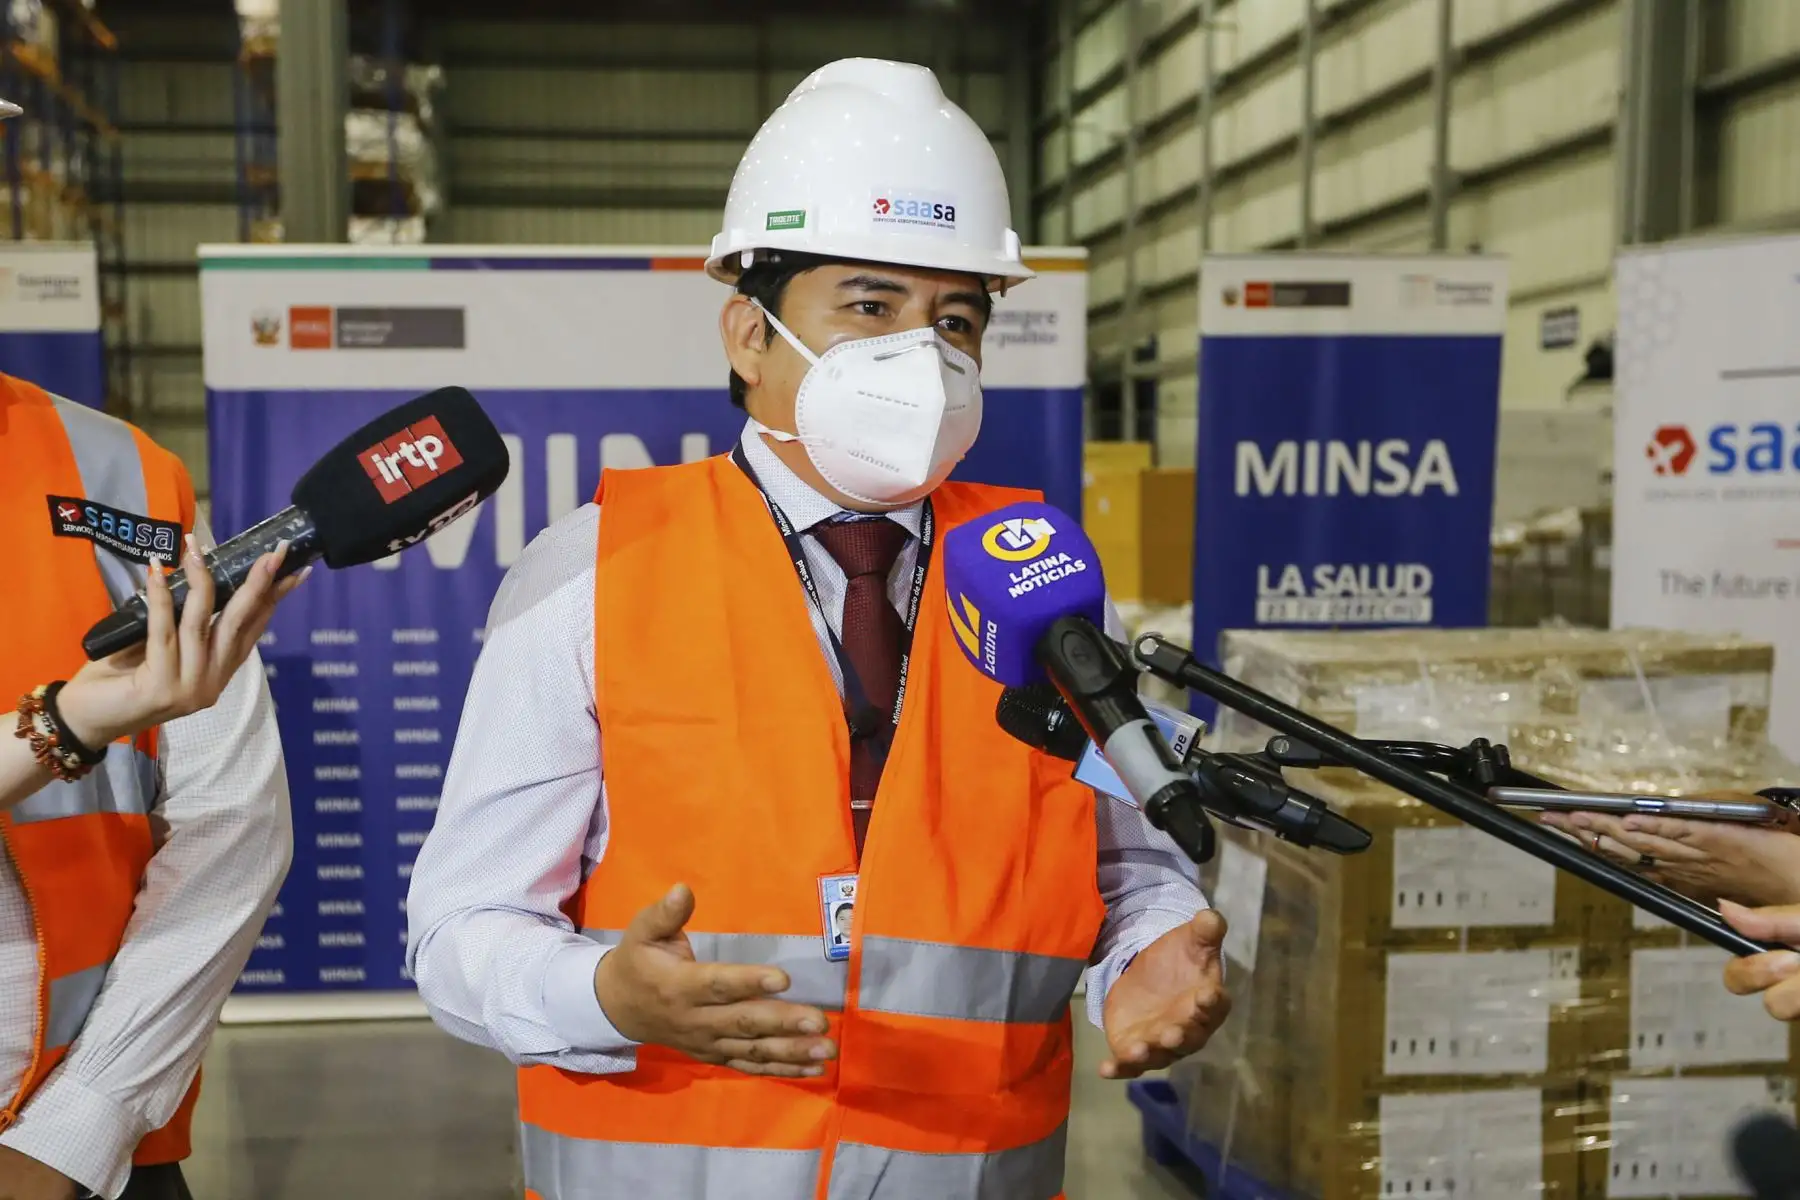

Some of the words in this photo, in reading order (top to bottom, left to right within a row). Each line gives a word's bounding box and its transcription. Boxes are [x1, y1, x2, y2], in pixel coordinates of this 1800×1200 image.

[893, 198, 956, 222] saasa
[371, 435, 444, 484] irtp
[1235, 439, 1459, 497] MINSA
[1707, 423, 1800, 474] sa
[63, 524, 94, 536] SERVICIOS
[84, 506, 175, 551] saasa
[1008, 559, 1087, 599] NOTICIAS
[1009, 552, 1072, 584] LATINA
[1257, 564, 1306, 596] LA
[1312, 564, 1433, 597] SALUD
[907, 598, 919, 632] Ministerio
[914, 586, 920, 597] de
[917, 566, 925, 587] Salud
[901, 655, 909, 675] Salud
[984, 620, 997, 675] Latina
[900, 674, 906, 683] de
[892, 685, 905, 726] Ministerio
